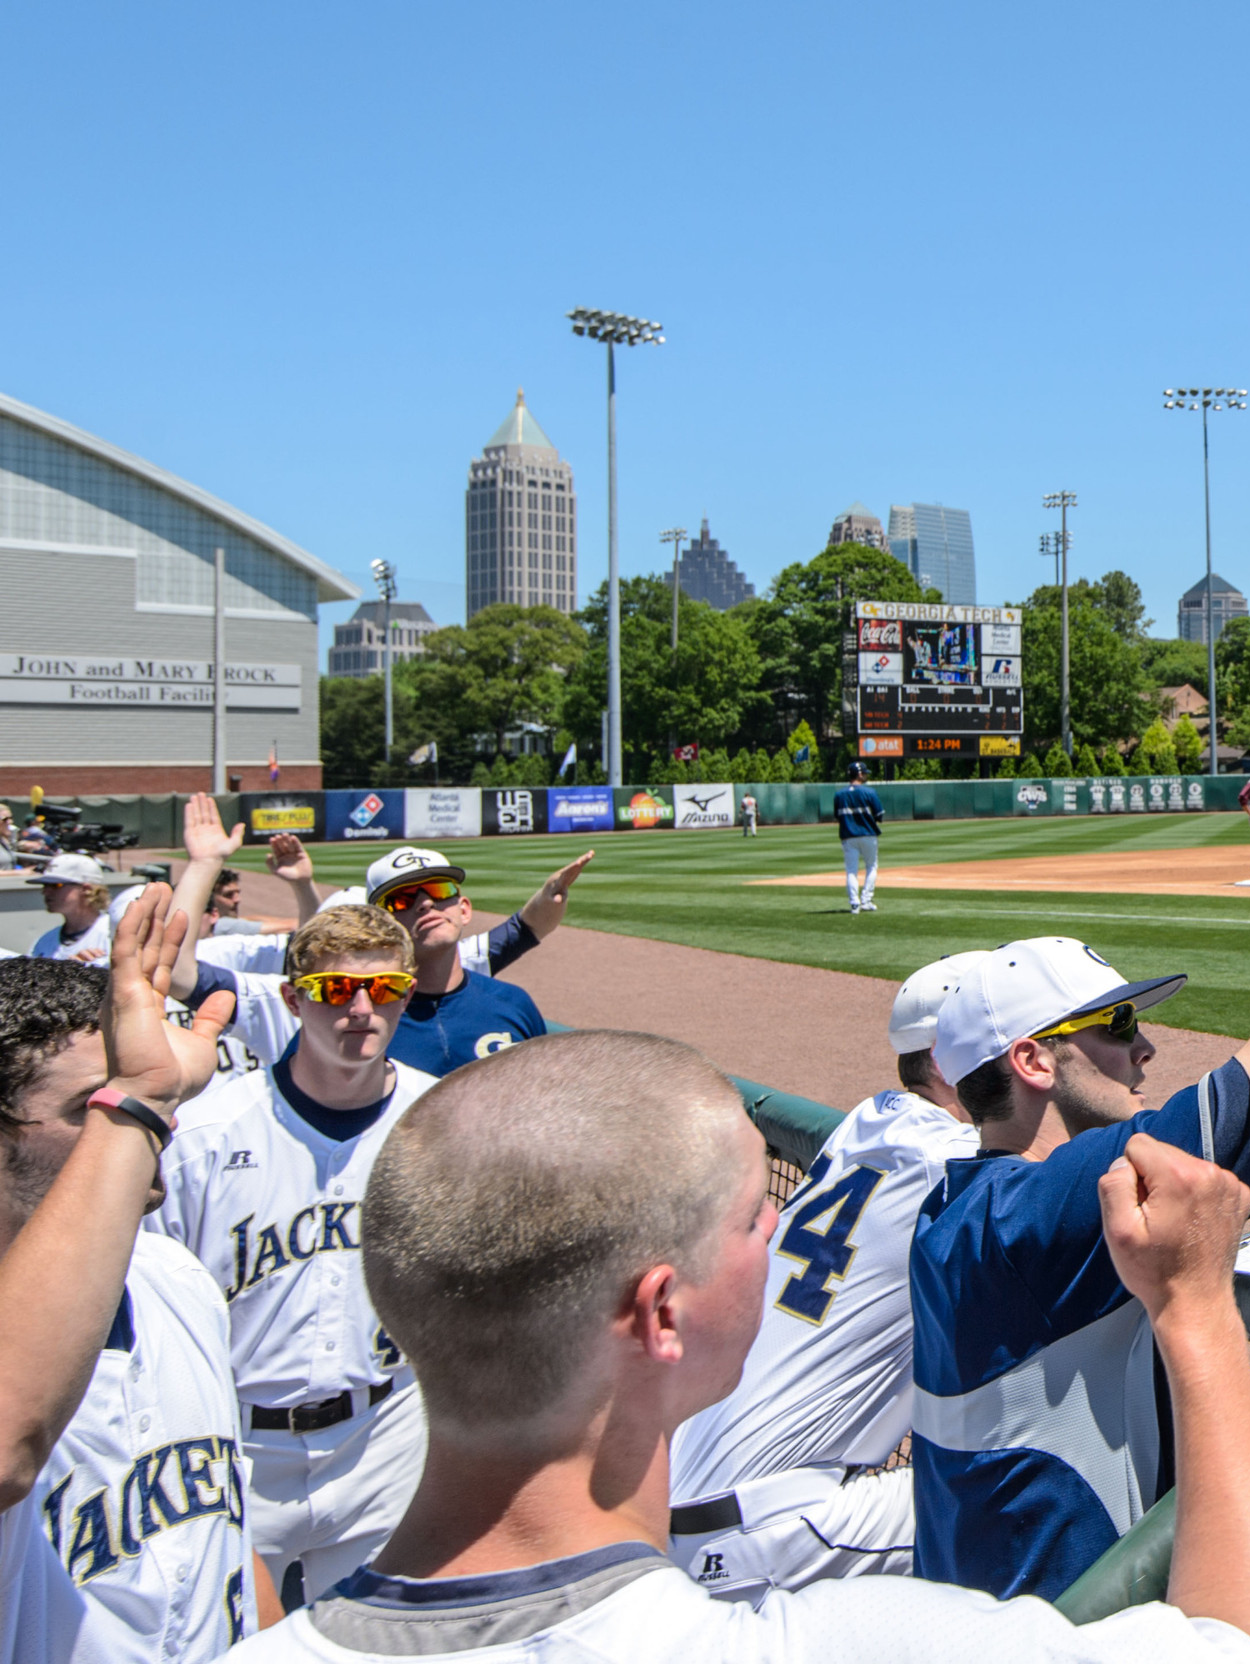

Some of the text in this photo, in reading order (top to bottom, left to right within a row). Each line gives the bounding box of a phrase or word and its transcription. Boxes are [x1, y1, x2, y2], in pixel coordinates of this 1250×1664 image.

[884, 603, 1002, 622] GEORGIA TECH
[12, 656, 77, 676] JOHN
[86, 662, 124, 677] and
[134, 660, 198, 680] MARY
[69, 683, 150, 700] Football
[917, 739, 961, 750] 1:24 PM
[428, 803, 460, 812] Medical
[555, 801, 608, 817] Aaron's
[621, 806, 672, 819] LOTTERY
[430, 814, 458, 823] Center
[344, 827, 389, 838] Domino's
[393, 852, 430, 869] GT
